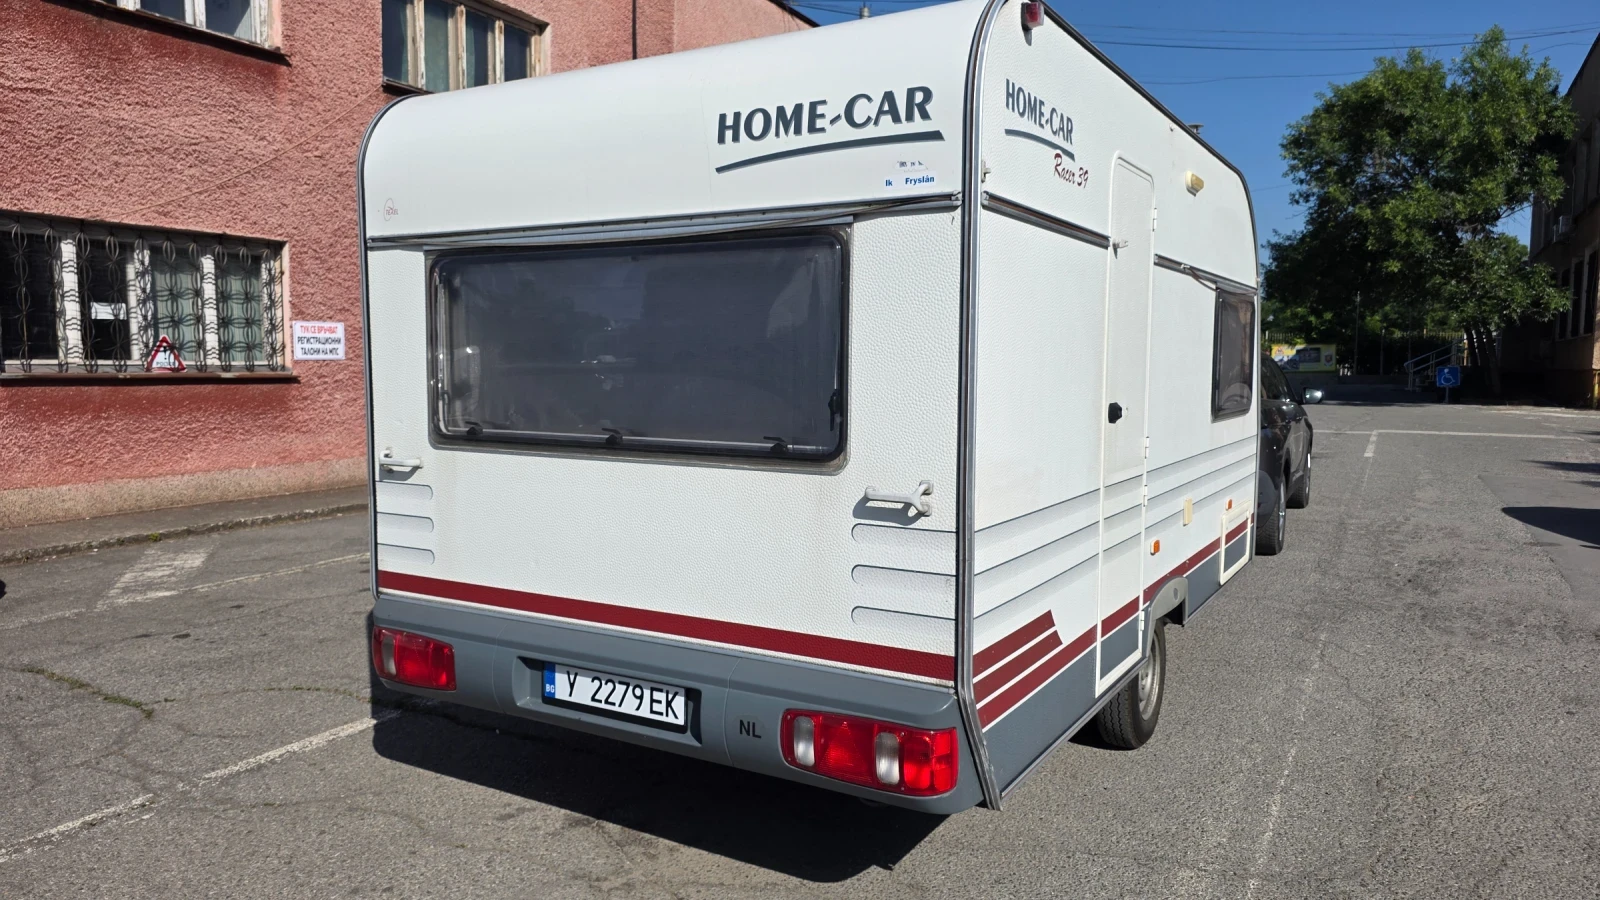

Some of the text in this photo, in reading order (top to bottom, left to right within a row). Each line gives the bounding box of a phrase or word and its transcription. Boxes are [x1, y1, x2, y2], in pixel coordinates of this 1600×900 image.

[717, 85, 933, 145] HOME-CAR
[1005, 78, 1074, 146] HOME-CAR
[1053, 152, 1089, 189] Racer 39
[297, 336, 341, 345] РЕГИСТРАЦИОННИ
[301, 347, 320, 355] ТАЛОНИ
[545, 683, 555, 693] BG
[590, 676, 645, 711] 2279
[649, 686, 679, 720] EK
[739, 719, 762, 739] NL
